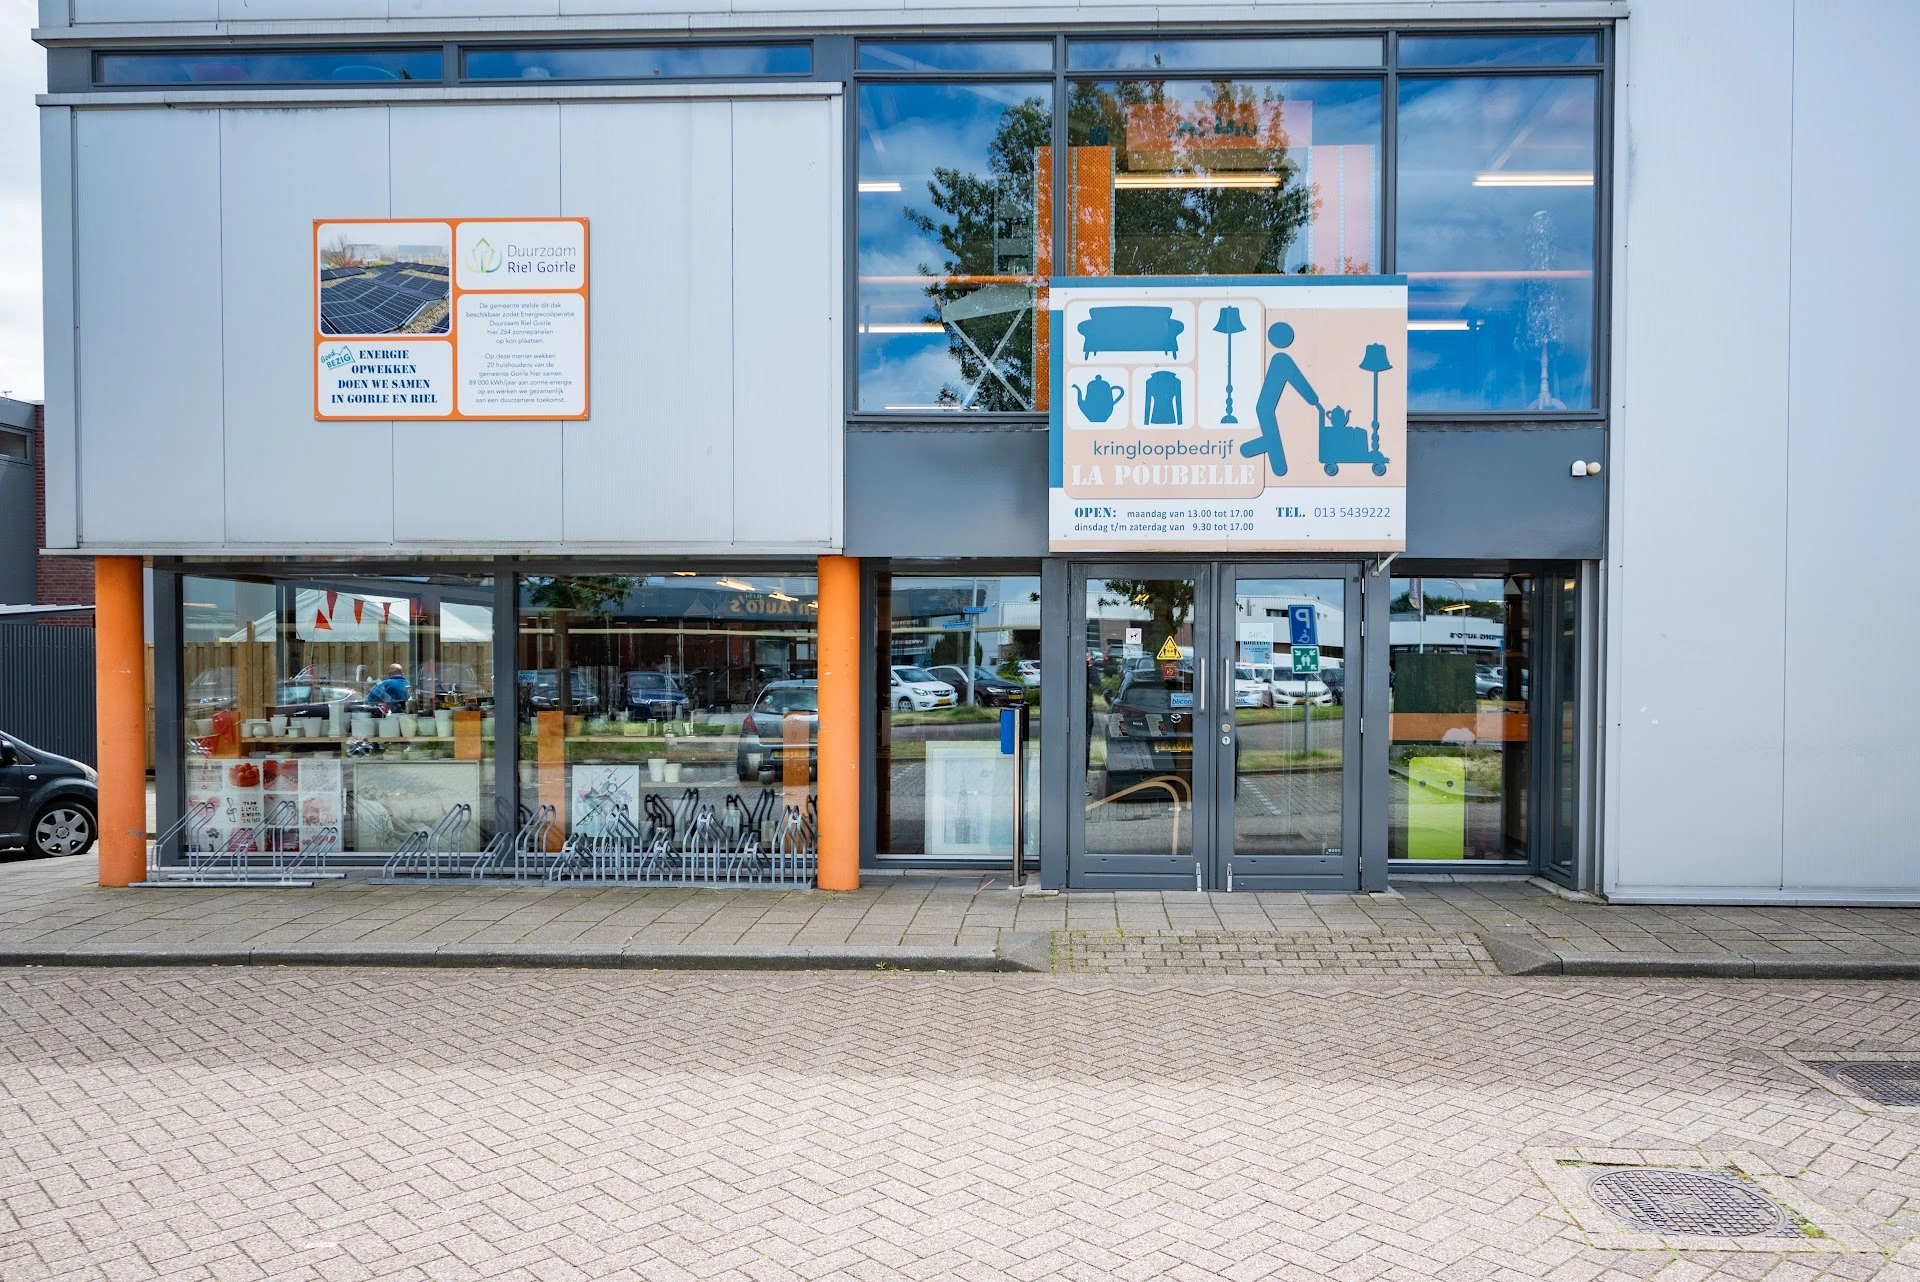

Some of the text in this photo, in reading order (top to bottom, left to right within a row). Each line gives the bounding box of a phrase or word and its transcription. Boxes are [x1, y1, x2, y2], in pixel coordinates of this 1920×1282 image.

[507, 244, 576, 258] Duurzaam
[508, 262, 576, 273] Riel Goirle
[359, 350, 409, 359] ENERGIE
[326, 353, 351, 368] BEZIG
[351, 364, 416, 374] OPWEKKEN
[338, 379, 430, 389] DOEN WE SAMEN
[528, 388, 564, 396] gezamenlijk
[332, 394, 438, 404] IN GOIRLE EN RIEL
[1094, 439, 1234, 460] kringloopbedrijf
[1071, 464, 1255, 486] LA POUBELLE
[1074, 507, 1116, 518] OPEN:
[1127, 509, 1167, 520] maandag
[1188, 509, 1212, 518] 13.00
[1230, 509, 1254, 518] 17.00
[1275, 507, 1390, 518] TEL. 013 5439222
[1074, 522, 1108, 533] dinsdag
[1110, 522, 1127, 532] t/m
[1129, 522, 1167, 533] zaterdag
[1192, 522, 1212, 531] 9.30
[1230, 522, 1254, 531] 17.00
